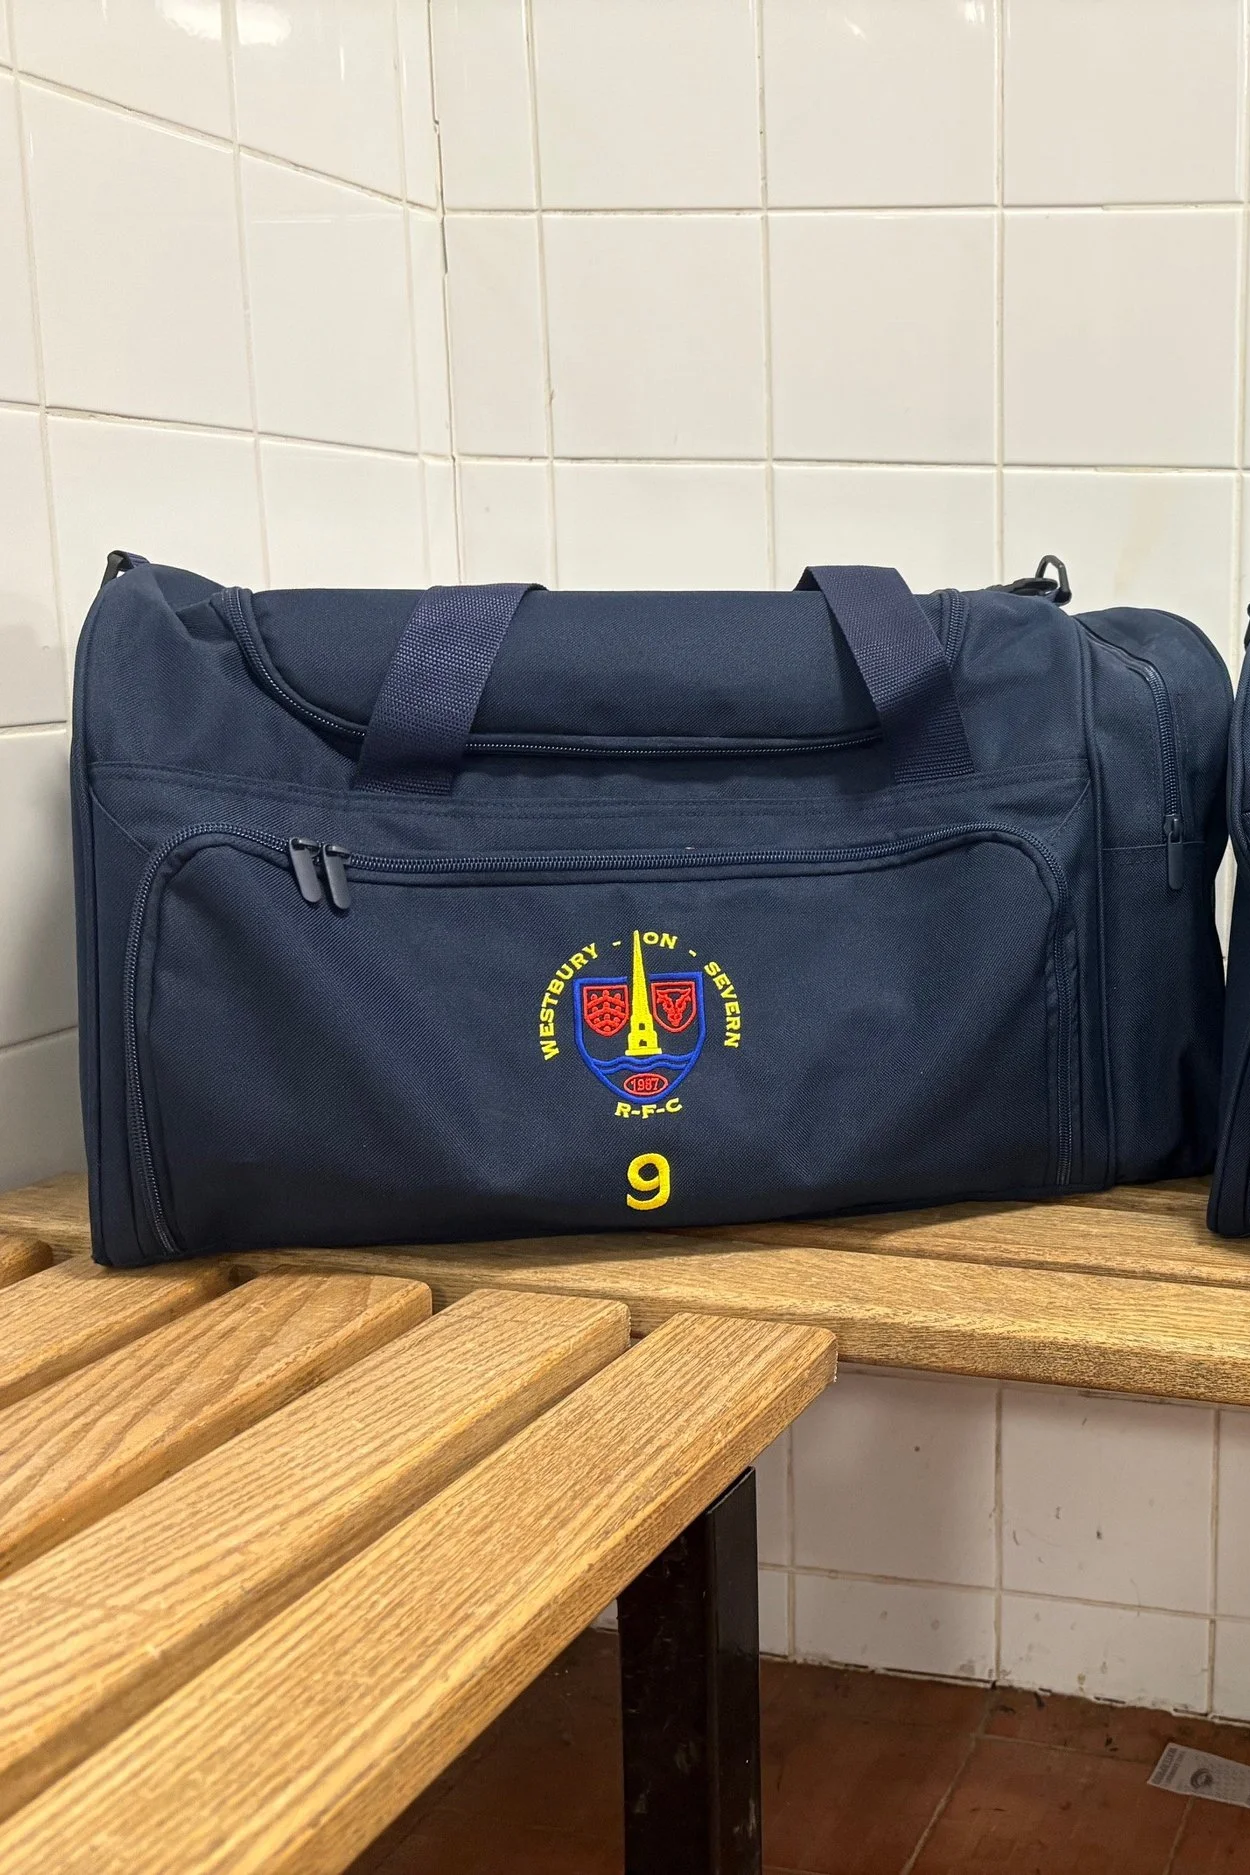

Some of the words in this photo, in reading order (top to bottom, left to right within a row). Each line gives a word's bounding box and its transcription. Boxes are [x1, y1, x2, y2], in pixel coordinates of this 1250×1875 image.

[537, 942, 599, 1061] WESTBURY
[643, 932, 678, 949] ON
[704, 961, 742, 1049] SEVERN
[615, 1098, 683, 1119] R-F-C
[627, 1153, 671, 1211] 9
